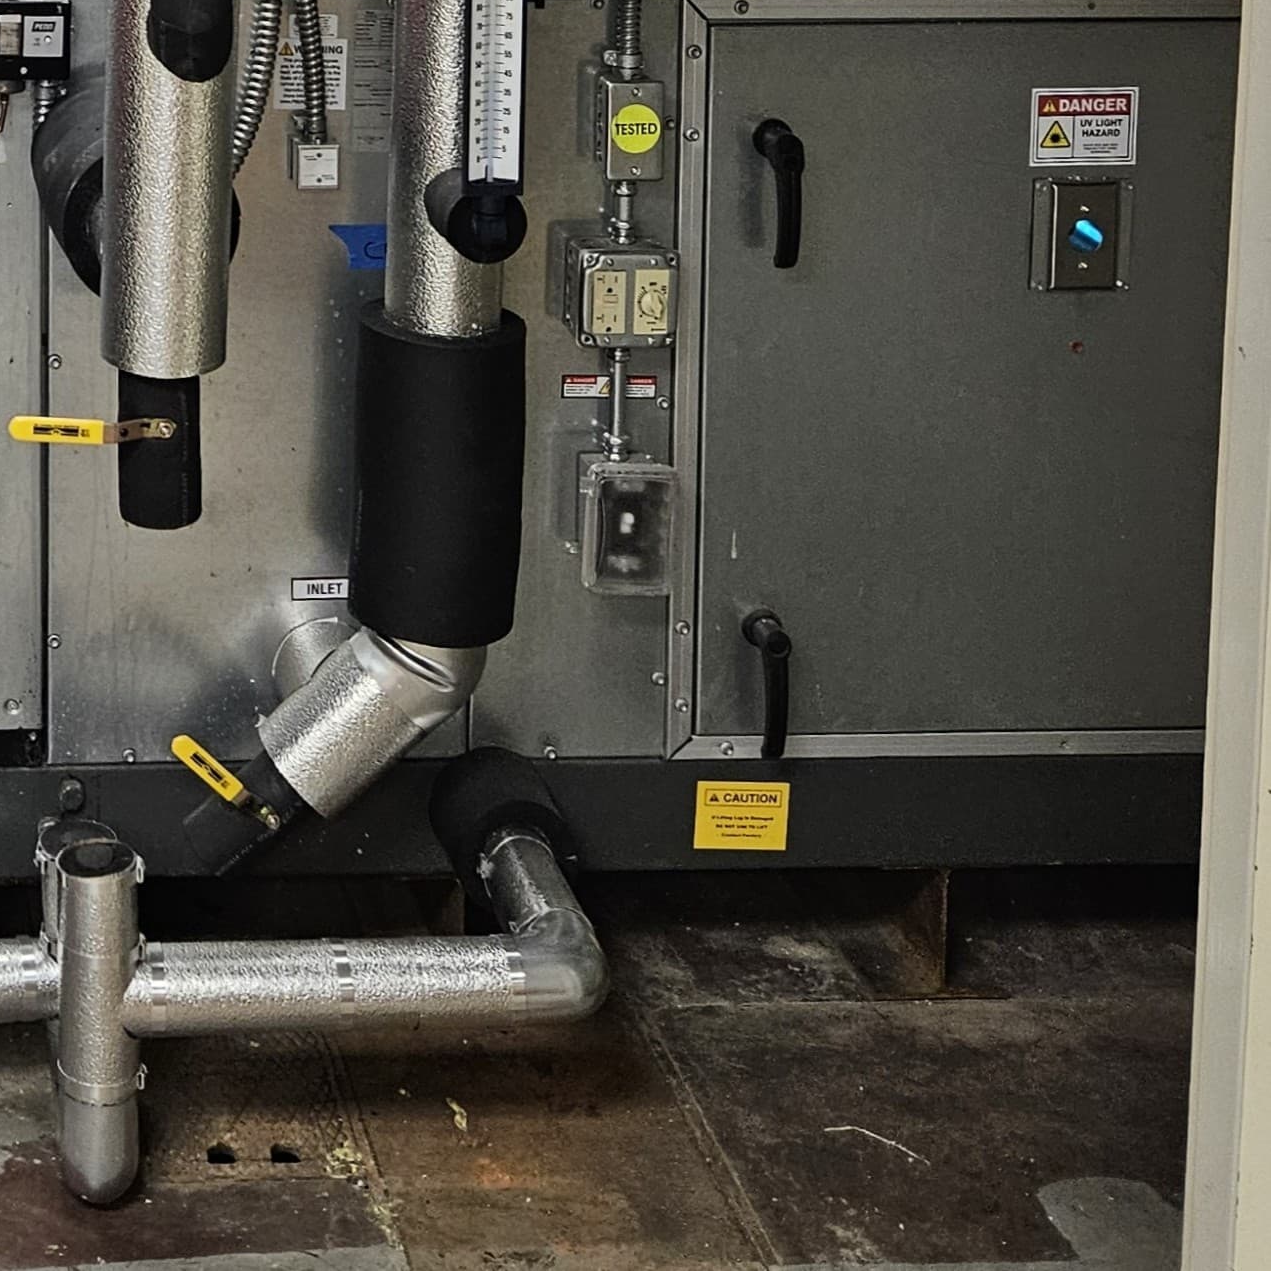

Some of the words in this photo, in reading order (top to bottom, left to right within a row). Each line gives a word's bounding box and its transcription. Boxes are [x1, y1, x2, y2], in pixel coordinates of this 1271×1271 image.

[1058, 98, 1128, 112] DANGER
[1080, 119, 1092, 127] UV
[1096, 118, 1123, 127] LIGHT
[615, 122, 658, 136] TESTED
[1082, 129, 1120, 138] HAZARD
[307, 582, 343, 594] INLET
[723, 793, 778, 803] CAUTION
